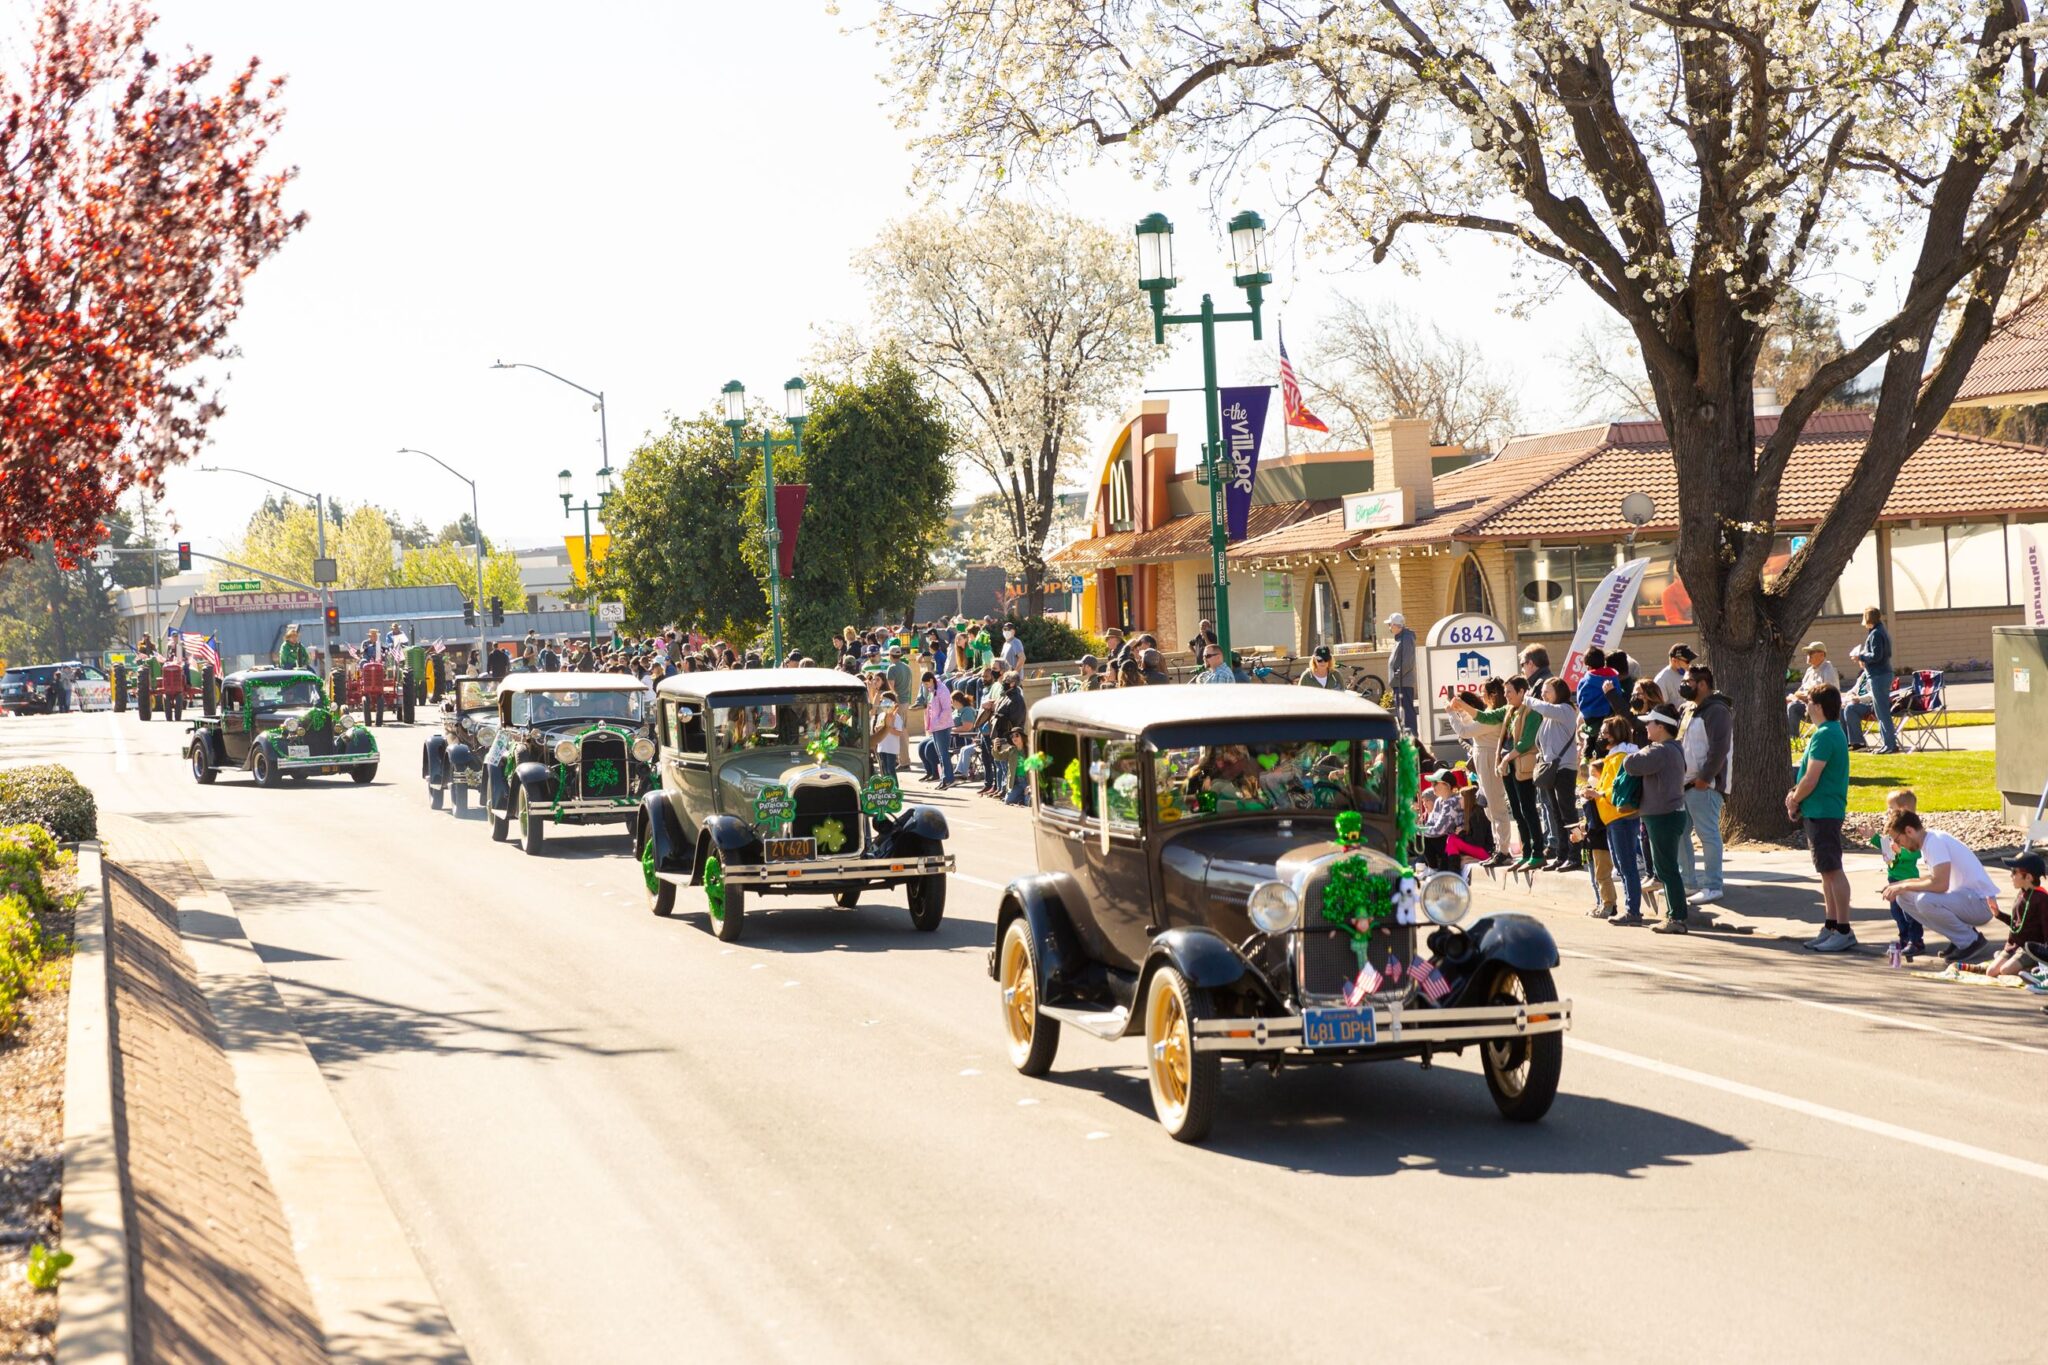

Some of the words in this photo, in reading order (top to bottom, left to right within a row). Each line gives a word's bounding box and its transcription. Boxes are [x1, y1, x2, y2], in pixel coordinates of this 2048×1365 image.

[1223, 402, 1247, 420] the
[1231, 420, 1254, 494] village
[220, 583, 242, 591] Dublin
[245, 581, 260, 590] Blvd
[1590, 575, 1632, 649] PPLIANCE
[1450, 626, 1495, 643] 6842
[867, 793, 897, 801] PATRICK'S
[759, 802, 789, 810] PATRICK'S
[1341, 1021, 1373, 1041] DPH
